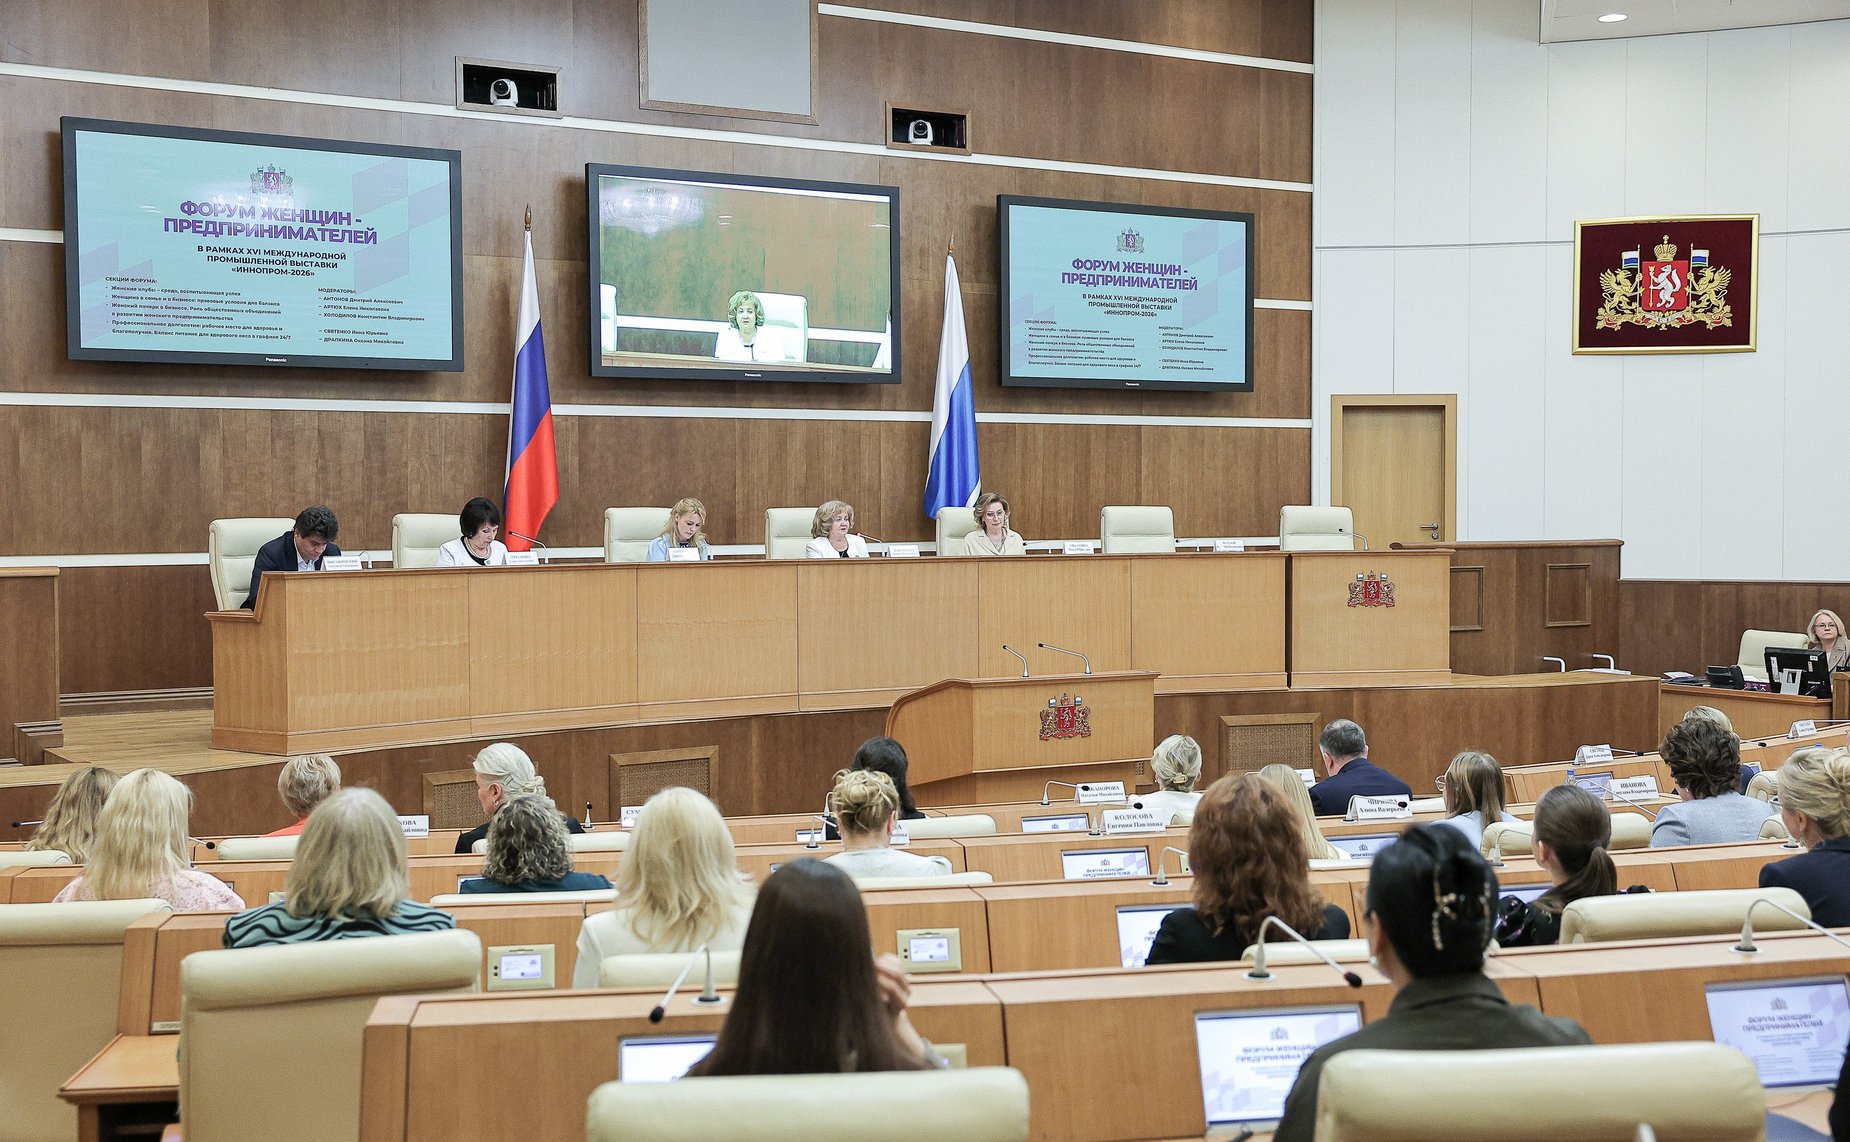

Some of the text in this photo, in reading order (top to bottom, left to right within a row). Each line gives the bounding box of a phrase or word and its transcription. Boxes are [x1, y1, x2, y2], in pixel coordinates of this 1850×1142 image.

[180, 200, 255, 219] ФОРУМ
[261, 206, 351, 226] ЖЕНЩИН
[164, 218, 377, 245] ПРЕДПРИНИМАТЕЛЕЙ
[206, 246, 244, 254] РАМКАХ
[264, 250, 346, 260] МЕЖДУНАРОДНОЙ
[207, 255, 287, 266] ПРОМЫШЛЕННОЙ
[231, 266, 314, 276] «ИННОПРОМ-2026»
[1072, 258, 1120, 272] ФОРУМ
[1122, 262, 1181, 276] ЖЕНЩИН
[1062, 272, 1197, 291] ПРЕДПРИНИМАТЕЛЕЙ
